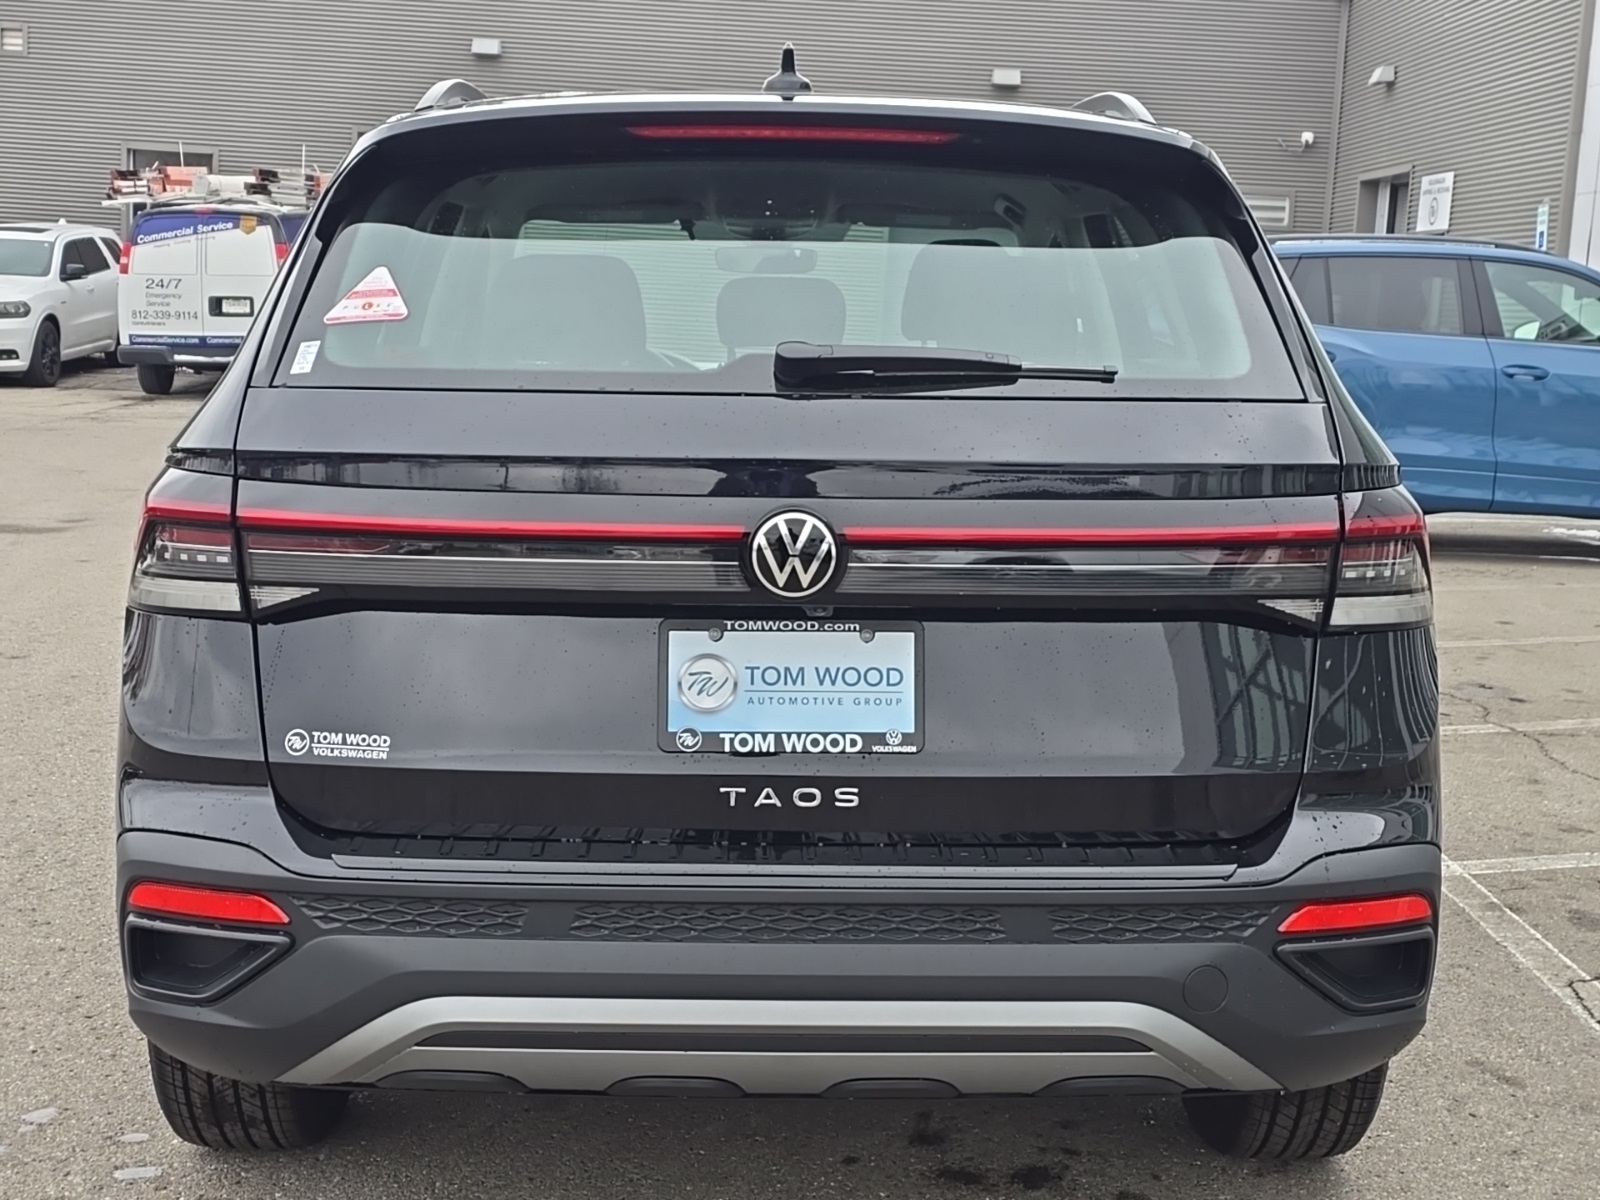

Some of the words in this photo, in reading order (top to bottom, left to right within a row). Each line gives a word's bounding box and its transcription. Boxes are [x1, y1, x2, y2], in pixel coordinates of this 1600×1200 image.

[137, 226, 193, 244] Commercial
[197, 221, 233, 233] Service
[145, 278, 182, 290] 24/7
[145, 291, 183, 300] Emergency
[145, 299, 171, 307] Service
[131, 309, 198, 320] 812-339-9114
[724, 620, 860, 632] TOMWOOD.com
[745, 666, 805, 687] TOM
[815, 666, 904, 688] WOOD
[747, 696, 844, 706] AUTOMOTIVE
[853, 697, 903, 707] GROUP
[311, 731, 343, 744] TOM
[345, 733, 391, 747] WOOD
[719, 733, 775, 753] TOM
[781, 733, 863, 753] WOOD
[312, 747, 388, 760] VOLKSWAGEN
[719, 787, 860, 808] TAOS
